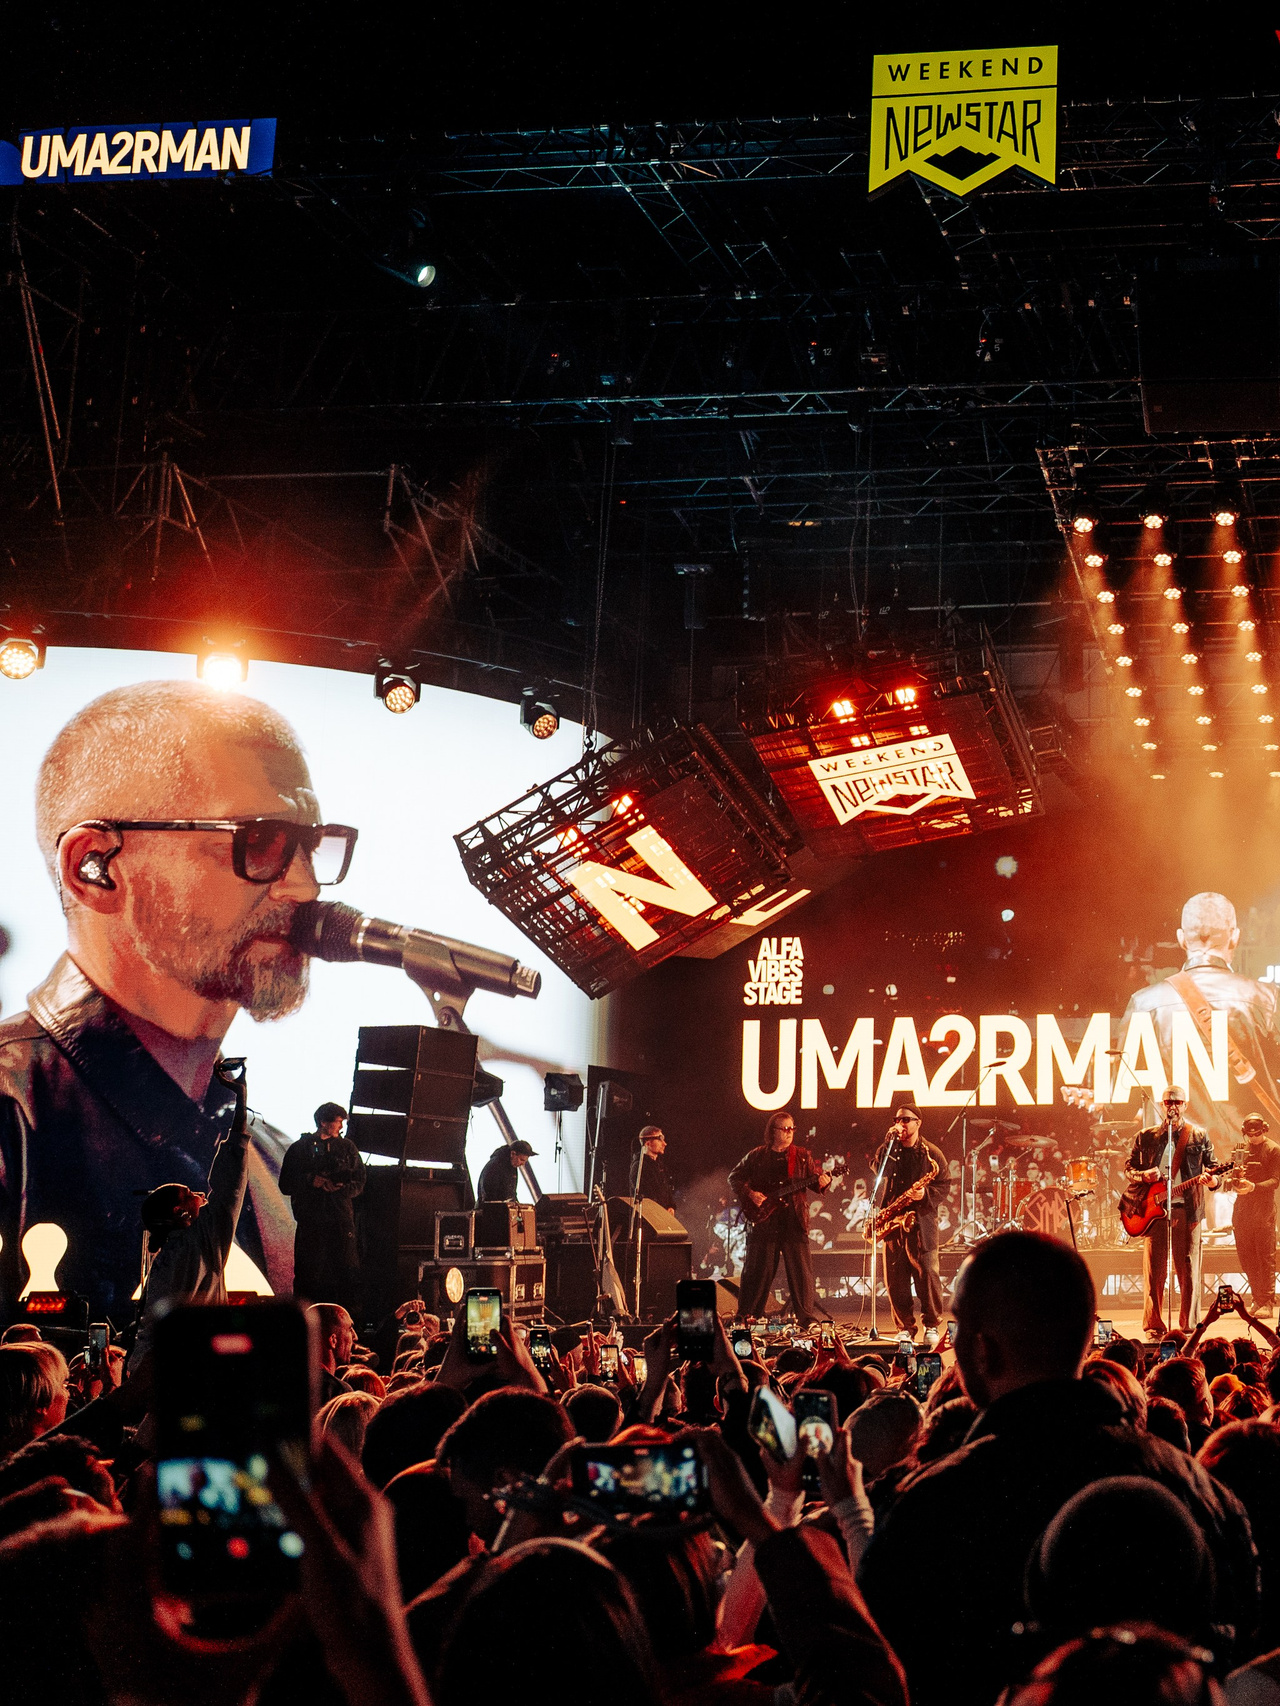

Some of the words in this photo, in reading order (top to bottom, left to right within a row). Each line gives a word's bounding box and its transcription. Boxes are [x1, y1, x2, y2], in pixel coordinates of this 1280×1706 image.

[887, 57, 1043, 82] WEEKEND
[21, 126, 251, 178] UMA2RMAN
[819, 741, 944, 773] WEEKEND
[566, 824, 718, 952] N
[757, 936, 804, 960] ALFA
[747, 959, 804, 982] VIBES
[743, 981, 803, 1006] STAGE
[741, 1010, 1229, 1111] UMA2RMAN
